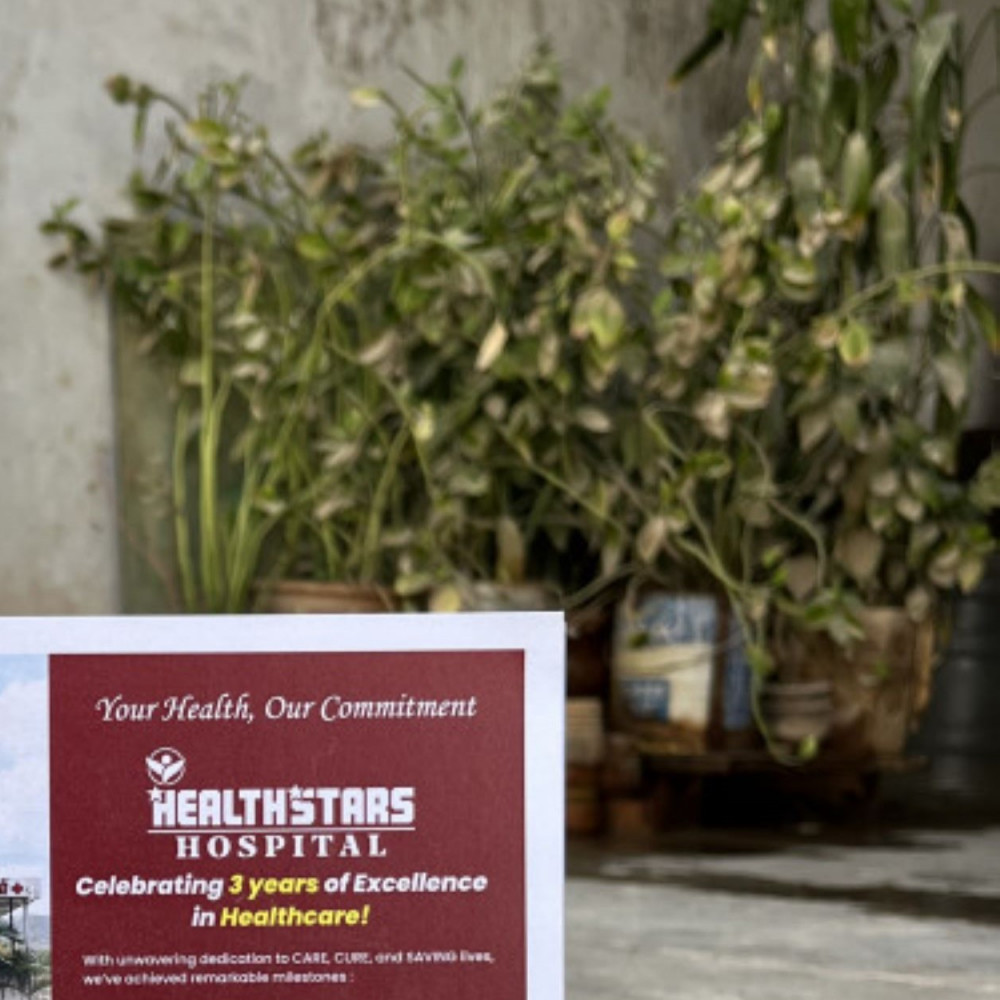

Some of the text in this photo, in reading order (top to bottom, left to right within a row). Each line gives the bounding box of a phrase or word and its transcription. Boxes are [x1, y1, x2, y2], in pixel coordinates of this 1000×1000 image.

[95, 692, 478, 724] Your Health, Our Commitment
[176, 832, 387, 859] HOSPITAL
[75, 871, 489, 900] Celebrating 3 years of Excellence
[191, 904, 371, 927] in Healthcare!
[83, 954, 114, 967] With
[116, 952, 197, 969] unwavering
[198, 952, 272, 966] dedication
[275, 953, 290, 965] to
[374, 951, 403, 964] and
[406, 950, 458, 964] SAVING
[83, 973, 123, 986] we've
[124, 971, 188, 986] achieved
[190, 971, 270, 984] remarkable
[272, 971, 347, 984] milestones
